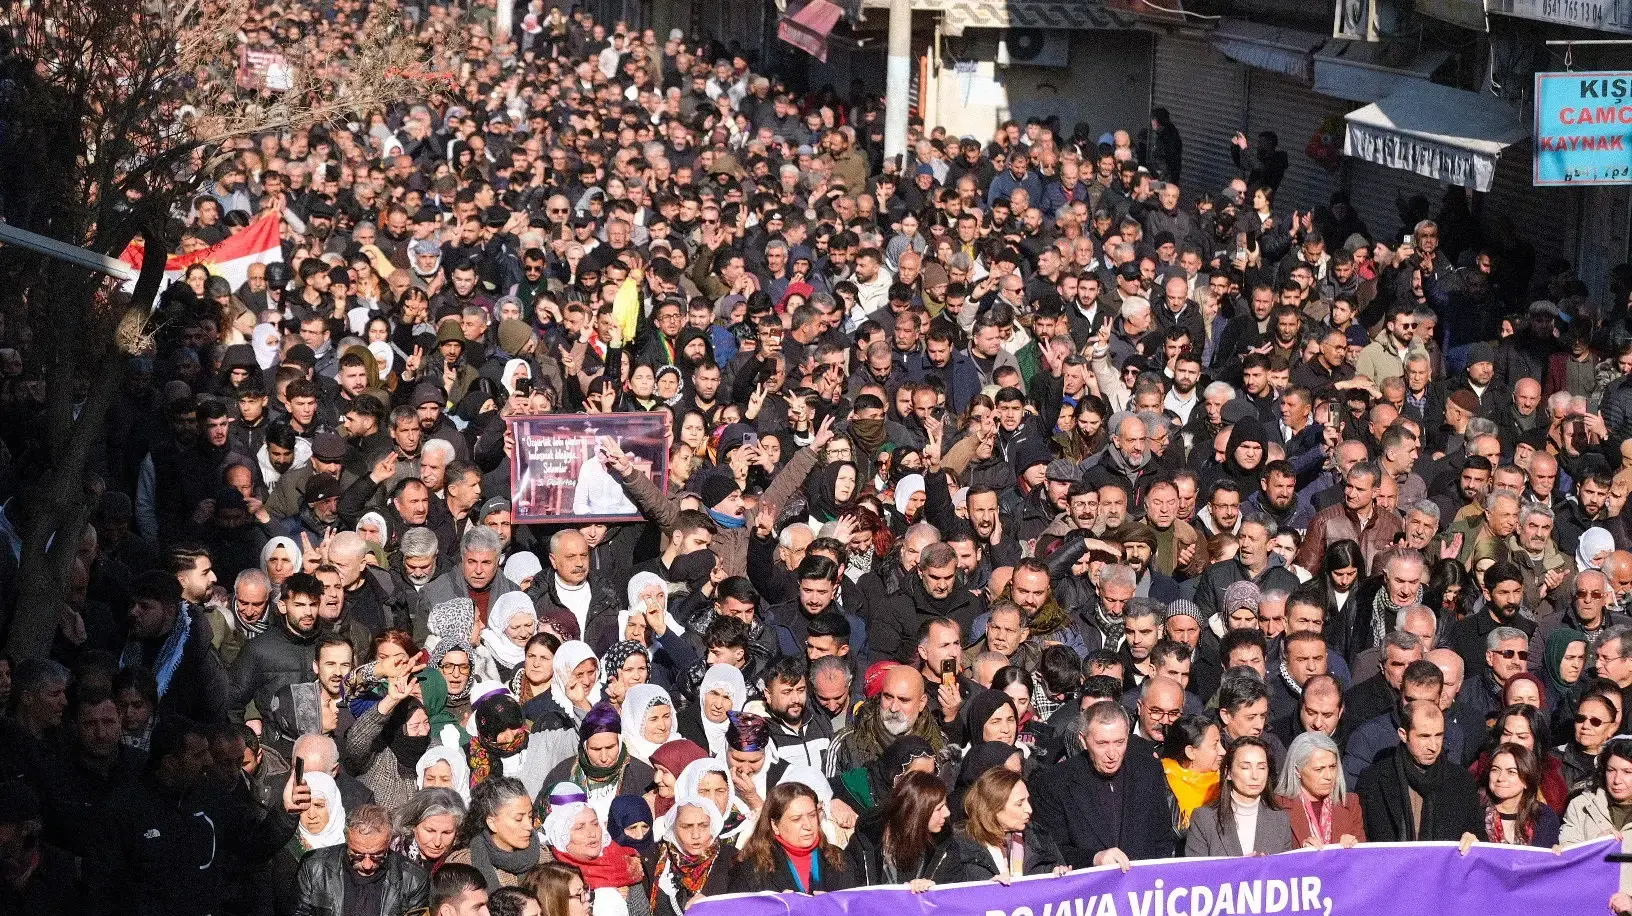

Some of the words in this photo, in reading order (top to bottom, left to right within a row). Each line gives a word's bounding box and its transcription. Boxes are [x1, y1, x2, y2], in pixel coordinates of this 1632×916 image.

[1564, 0, 1578, 20] 765
[1581, 2, 1590, 22] 13
[1580, 78, 1632, 104] KIŞ
[1540, 135, 1624, 152] KAYNAK
